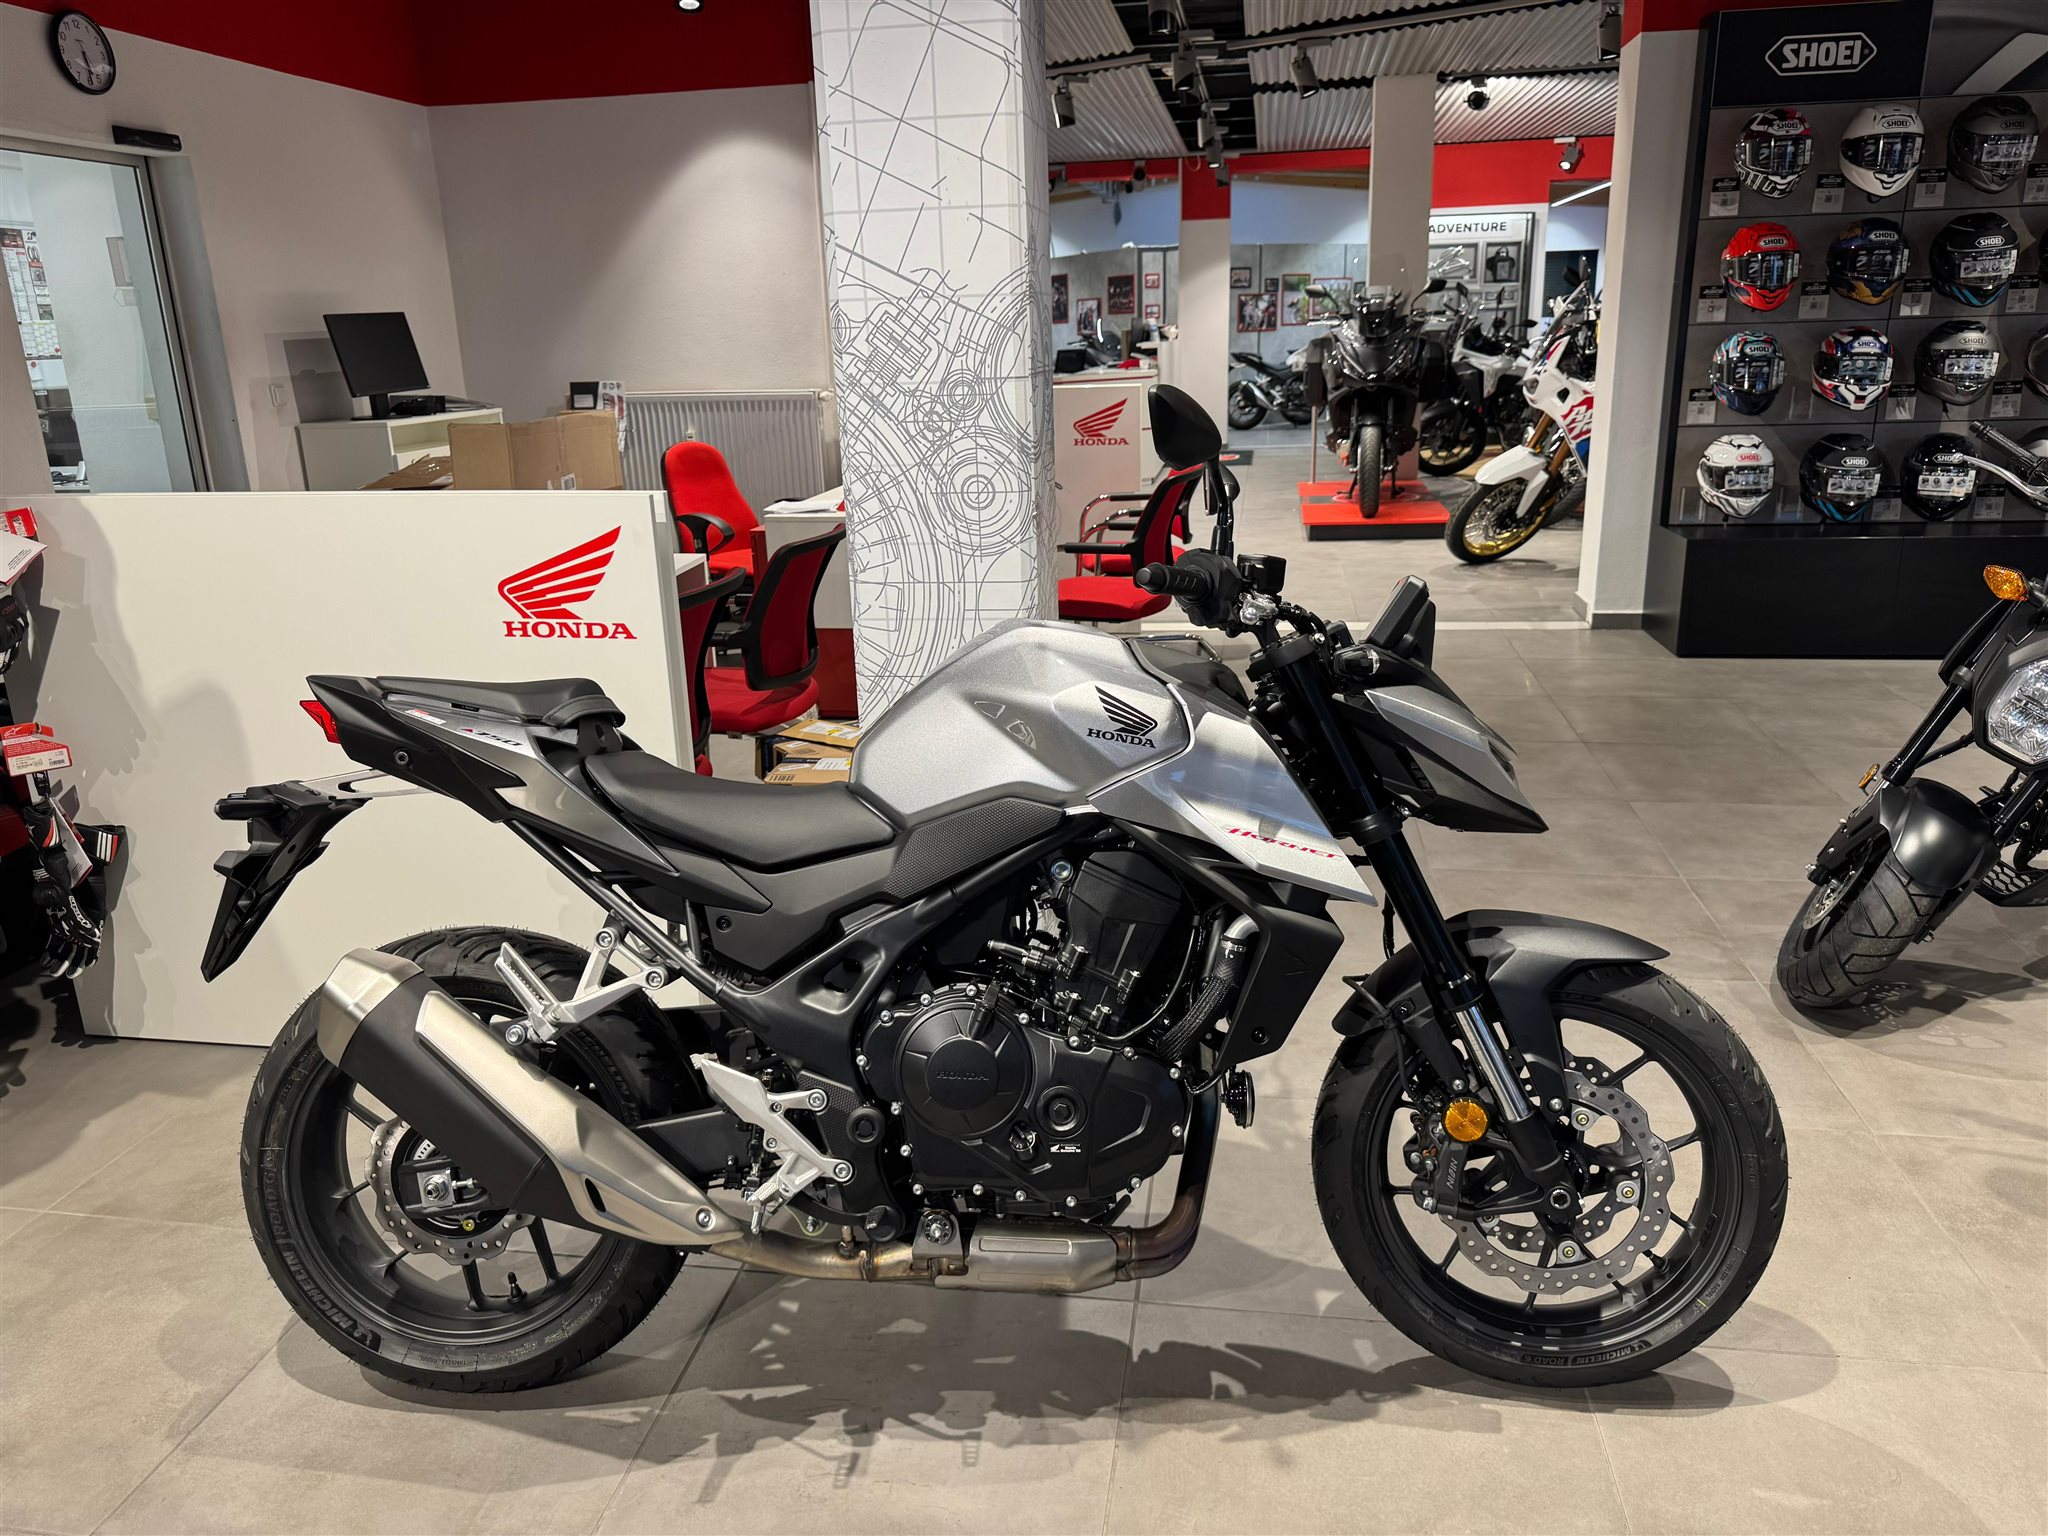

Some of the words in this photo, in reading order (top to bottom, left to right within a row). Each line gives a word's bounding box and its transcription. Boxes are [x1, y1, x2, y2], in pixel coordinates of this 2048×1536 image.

[63, 20, 70, 31] 11
[72, 18, 81, 29] 12
[1781, 40, 1862, 68] SHOEI
[1776, 122, 1798, 130] SHOEI
[1429, 222, 1507, 233] ADVENTURE
[1763, 238, 1785, 246] SHOEI
[1980, 237, 2002, 246] SHOEI
[1074, 438, 1129, 446] HONDA
[502, 621, 638, 639] HONDA
[475, 731, 524, 747] 750
[1087, 728, 1157, 749] HONDA
[936, 1071, 990, 1081] HONDA
[283, 1249, 353, 1329] MICHELIN
[1575, 1346, 1631, 1364] MICHELIN
[1534, 1356, 1565, 1366] ROAD
